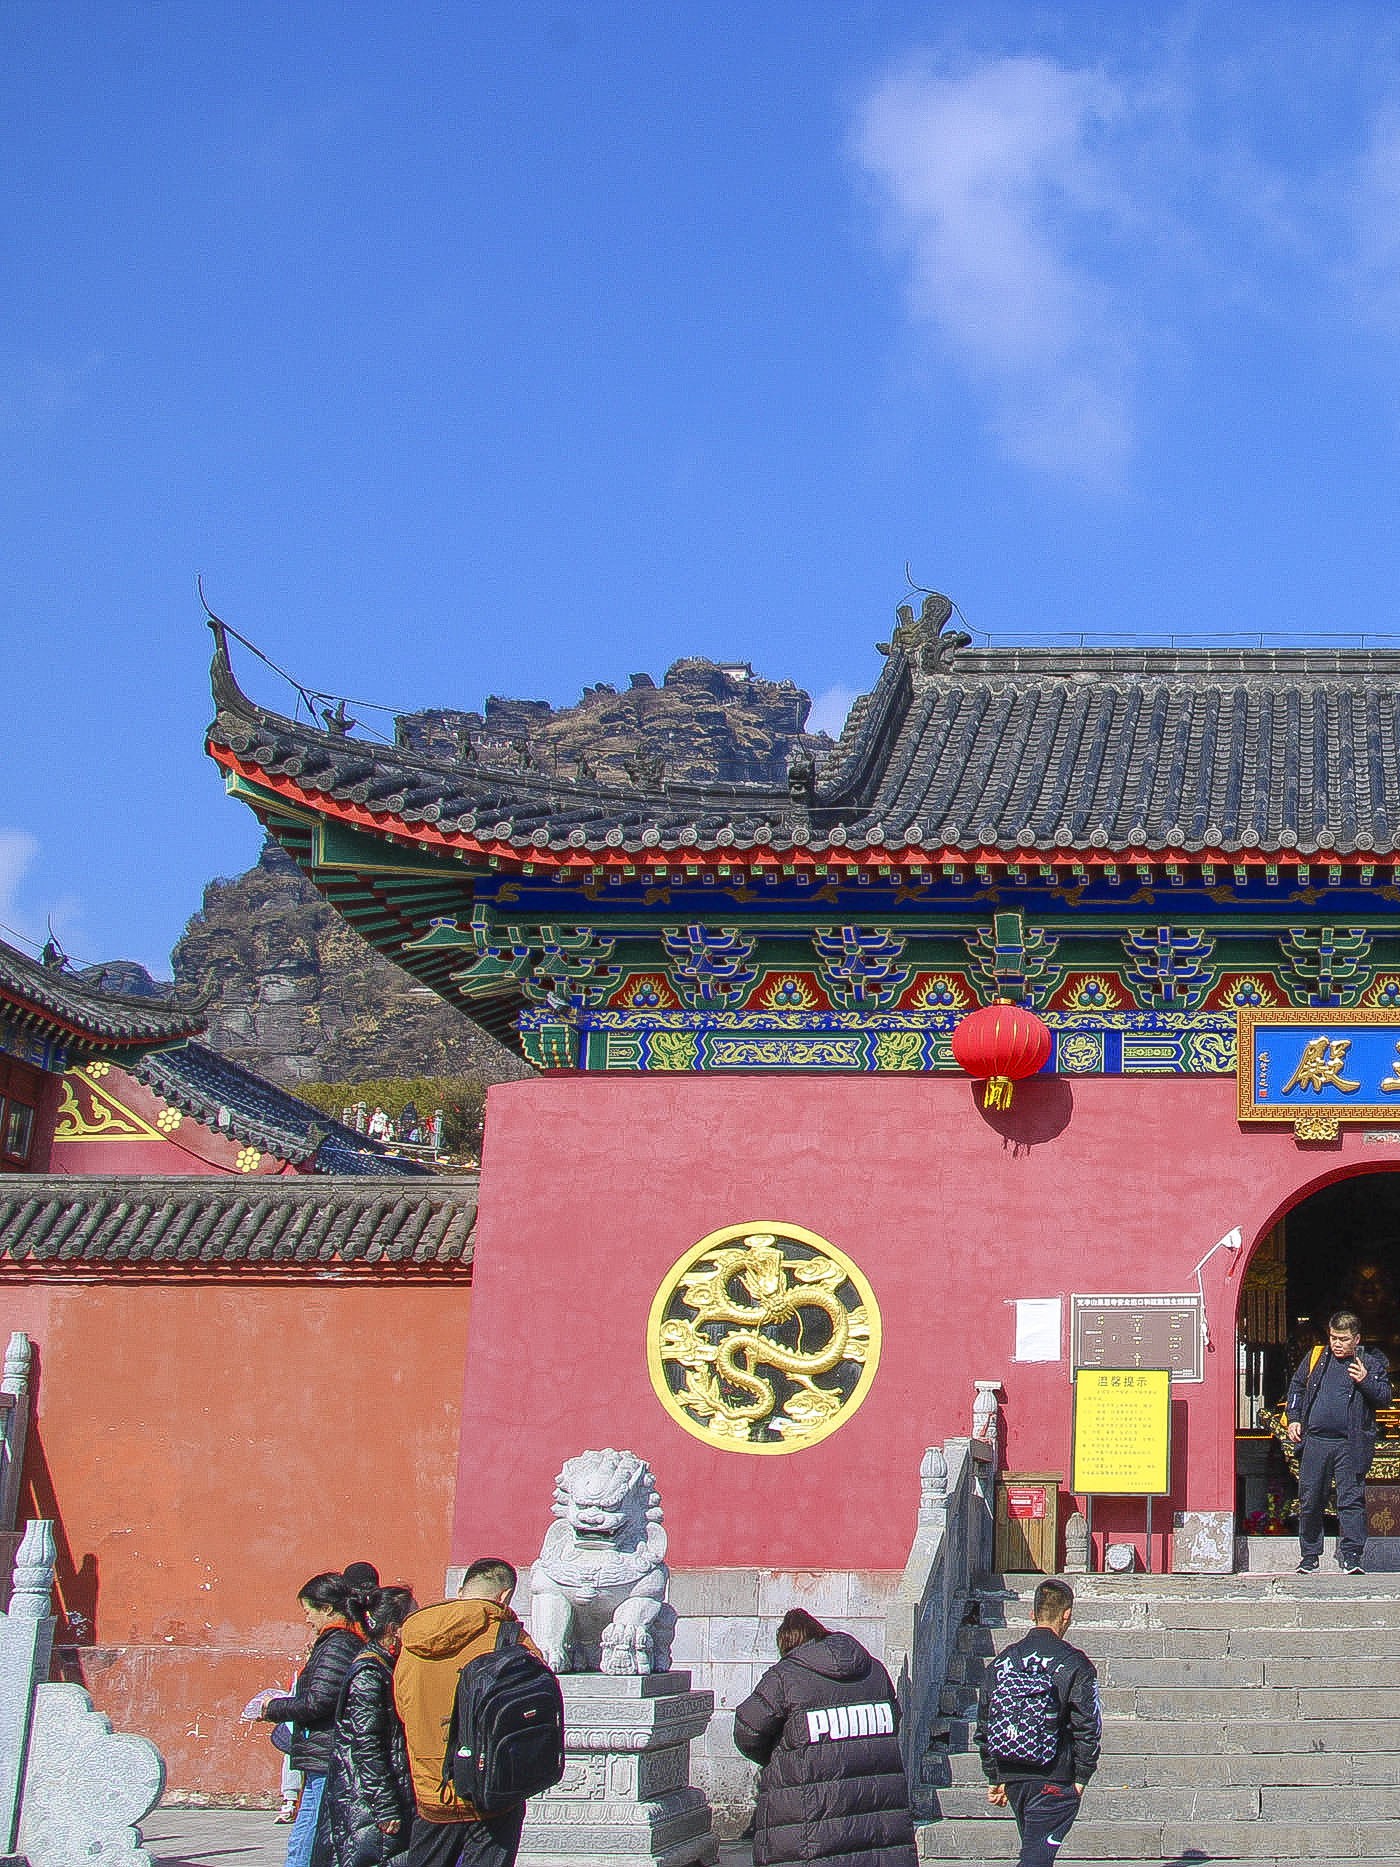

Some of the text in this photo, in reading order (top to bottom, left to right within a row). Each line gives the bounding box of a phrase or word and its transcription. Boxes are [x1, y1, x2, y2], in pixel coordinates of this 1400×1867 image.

[1098, 1376, 1148, 1387] 温馨提示
[806, 1702, 894, 1743] PUMA
